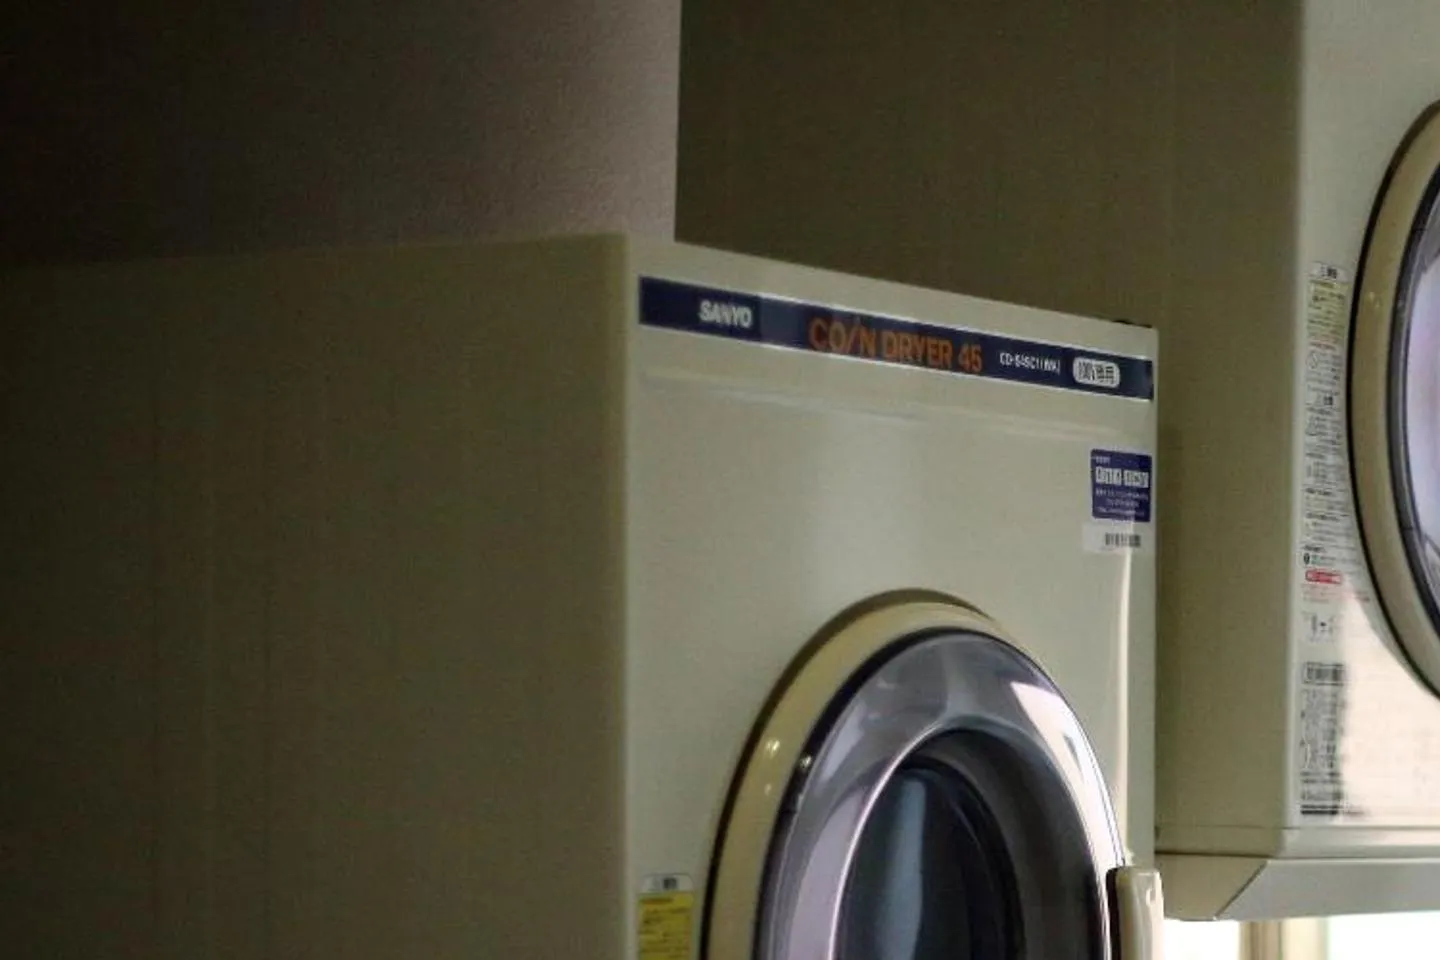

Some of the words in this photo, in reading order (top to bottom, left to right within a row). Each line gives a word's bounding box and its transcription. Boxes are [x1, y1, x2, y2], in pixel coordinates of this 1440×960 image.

[699, 299, 754, 329] SANYO
[881, 330, 954, 371] DRYER
[958, 343, 984, 373] 45
